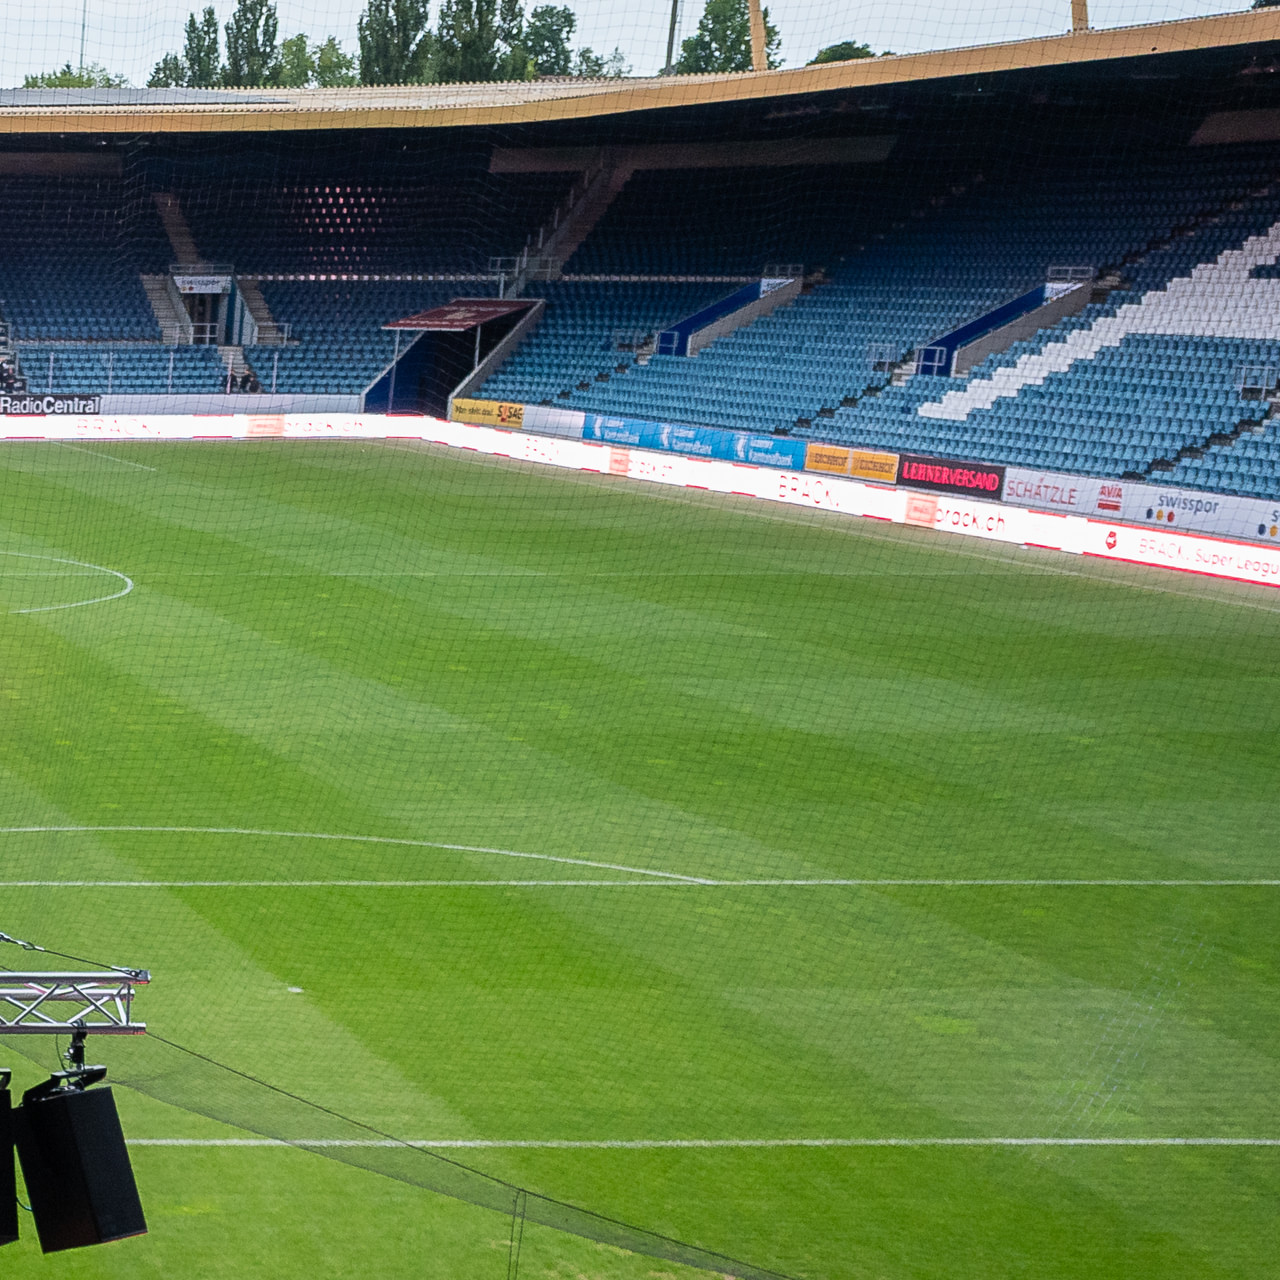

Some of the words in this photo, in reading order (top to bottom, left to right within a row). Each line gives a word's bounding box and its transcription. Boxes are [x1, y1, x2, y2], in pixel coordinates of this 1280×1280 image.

[0, 396, 100, 414] RadioCentral
[903, 461, 999, 492] LEHNERVERSAND
[1099, 484, 1123, 499] AVIA
[1158, 492, 1219, 515] swisspor
[1195, 548, 1233, 566] Super
[1237, 558, 1280, 577] Leagu
